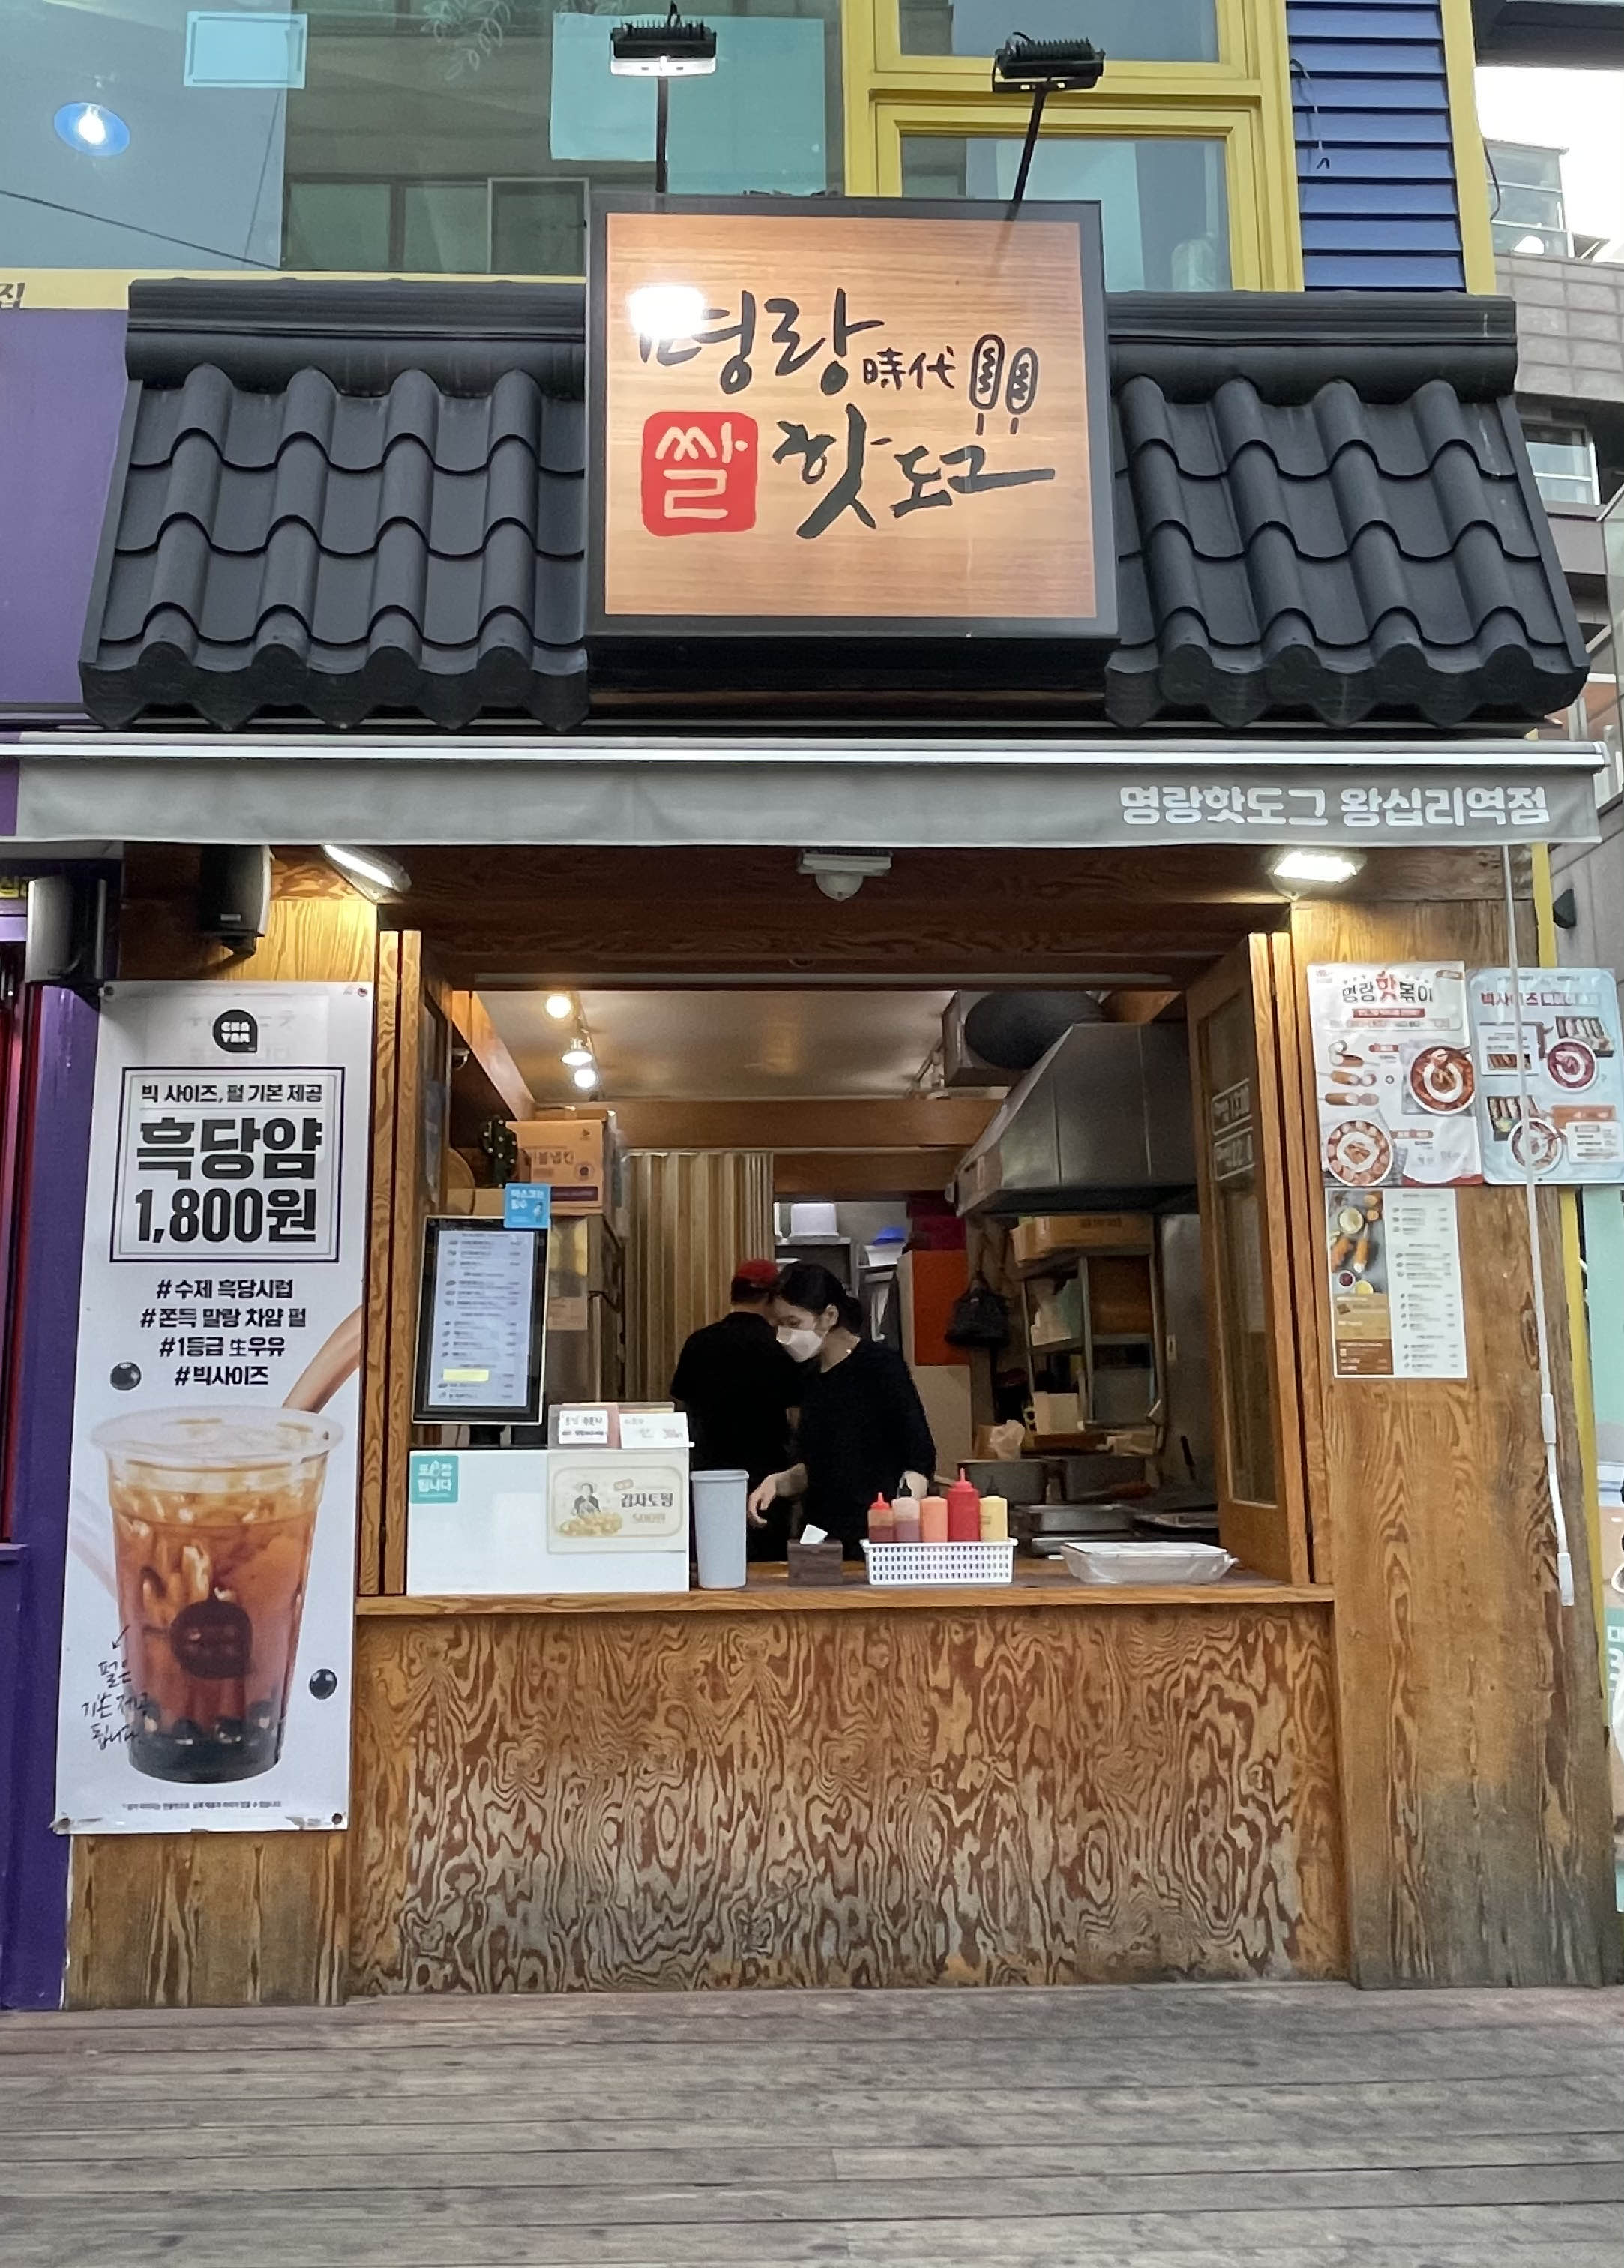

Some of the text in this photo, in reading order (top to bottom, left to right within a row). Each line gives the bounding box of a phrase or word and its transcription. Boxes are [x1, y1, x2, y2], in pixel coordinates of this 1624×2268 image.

[862, 346, 956, 390] 時代
[655, 422, 748, 520] 쌀
[772, 403, 1056, 540] 핫도그
[1119, 786, 1551, 826] 명랑핫도그 왕십리역점
[141, 1084, 158, 1102] 빅
[248, 1084, 283, 1102] 기본
[287, 1084, 322, 1102] 제공
[136, 1117, 322, 1180] 흑당얌
[135, 1188, 316, 1244] 1,800원
[217, 1279, 293, 1299] 흑당시럽
[202, 1308, 240, 1328] 말랑
[288, 1308, 306, 1328] 펄
